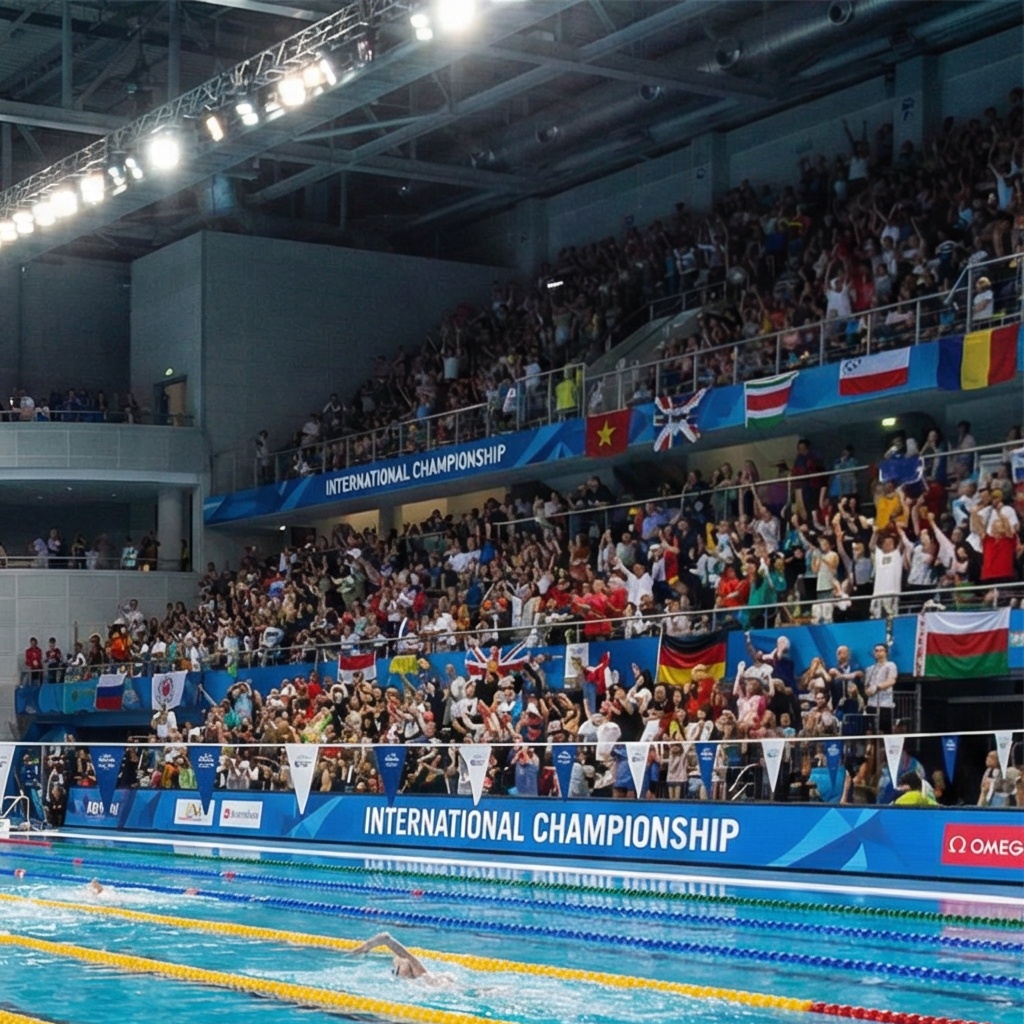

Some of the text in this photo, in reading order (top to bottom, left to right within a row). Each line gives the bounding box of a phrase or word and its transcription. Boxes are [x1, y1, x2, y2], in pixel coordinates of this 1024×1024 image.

[325, 444, 507, 496] INTERNATIONAL CHAMPIONSHIP
[364, 806, 740, 852] INTERNATIONAL CHAMPIONSHIP
[970, 838, 1024, 857] OMEG
